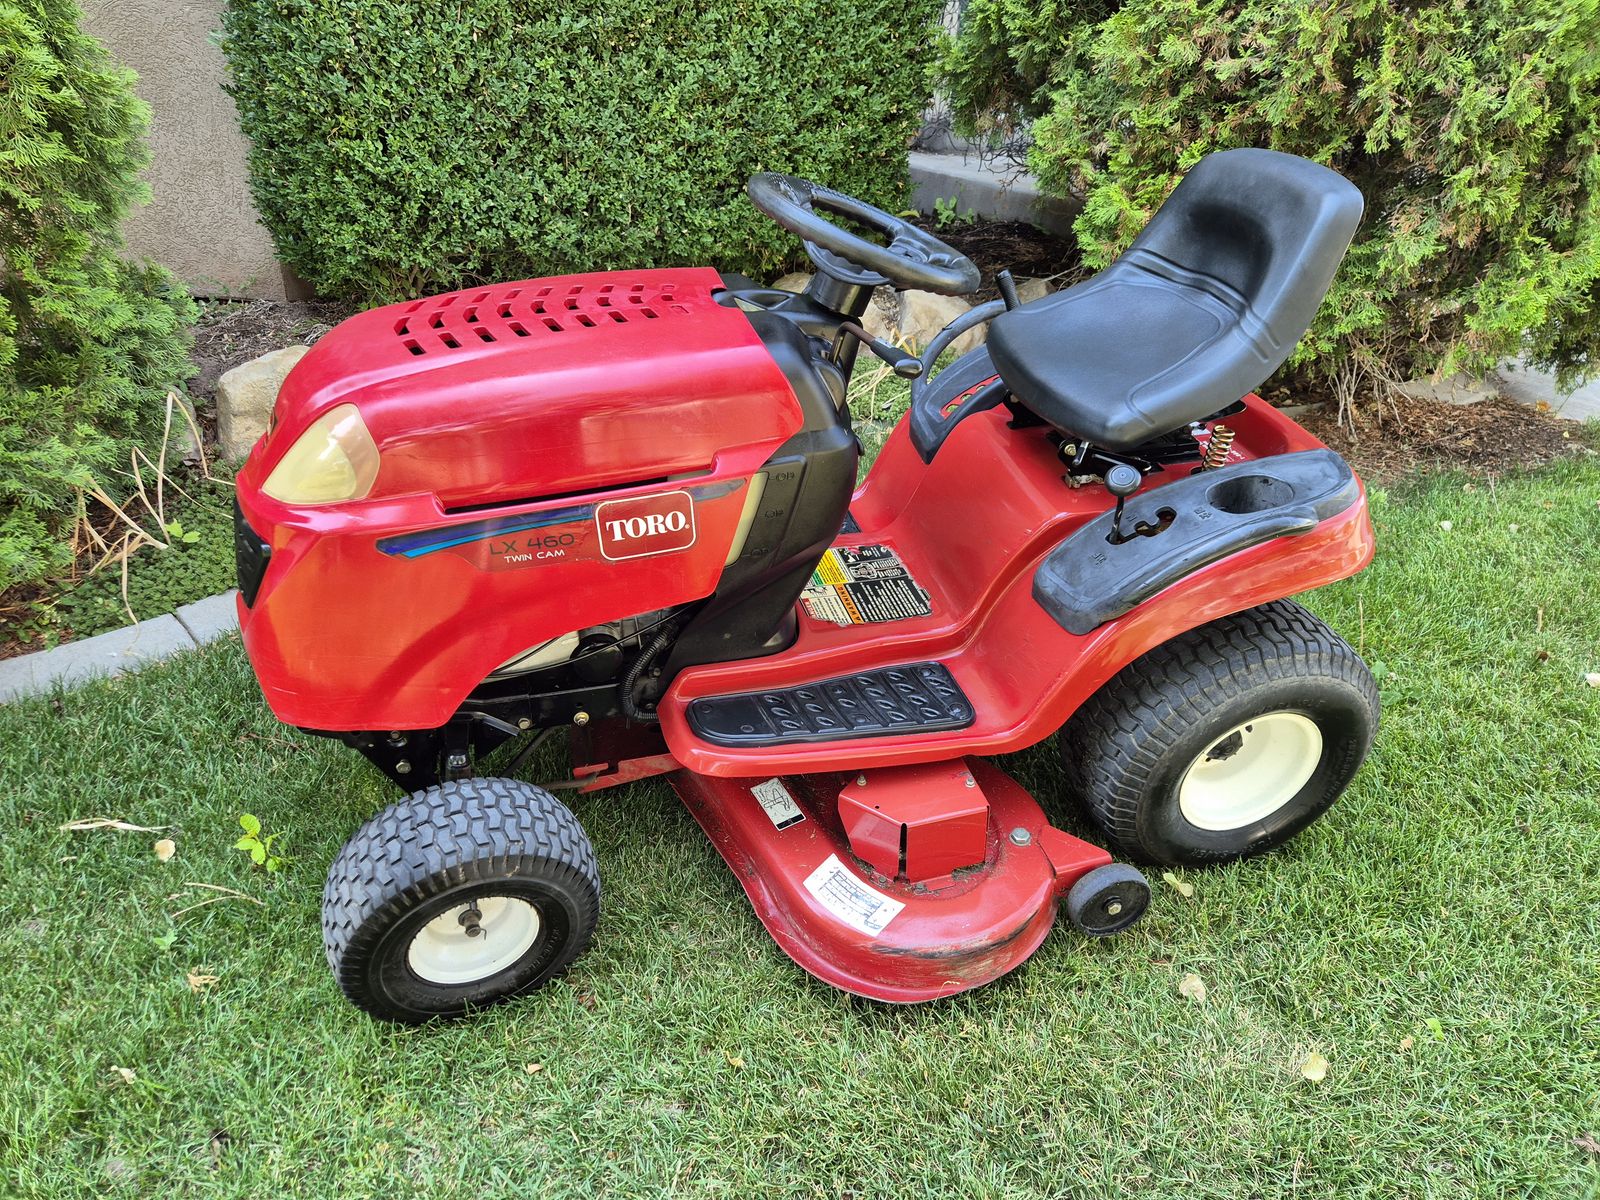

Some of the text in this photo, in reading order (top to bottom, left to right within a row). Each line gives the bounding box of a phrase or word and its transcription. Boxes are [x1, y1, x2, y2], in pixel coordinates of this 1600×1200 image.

[605, 510, 690, 542] TORO
[489, 533, 575, 555] LX 460
[504, 549, 565, 564] TWIN CAM
